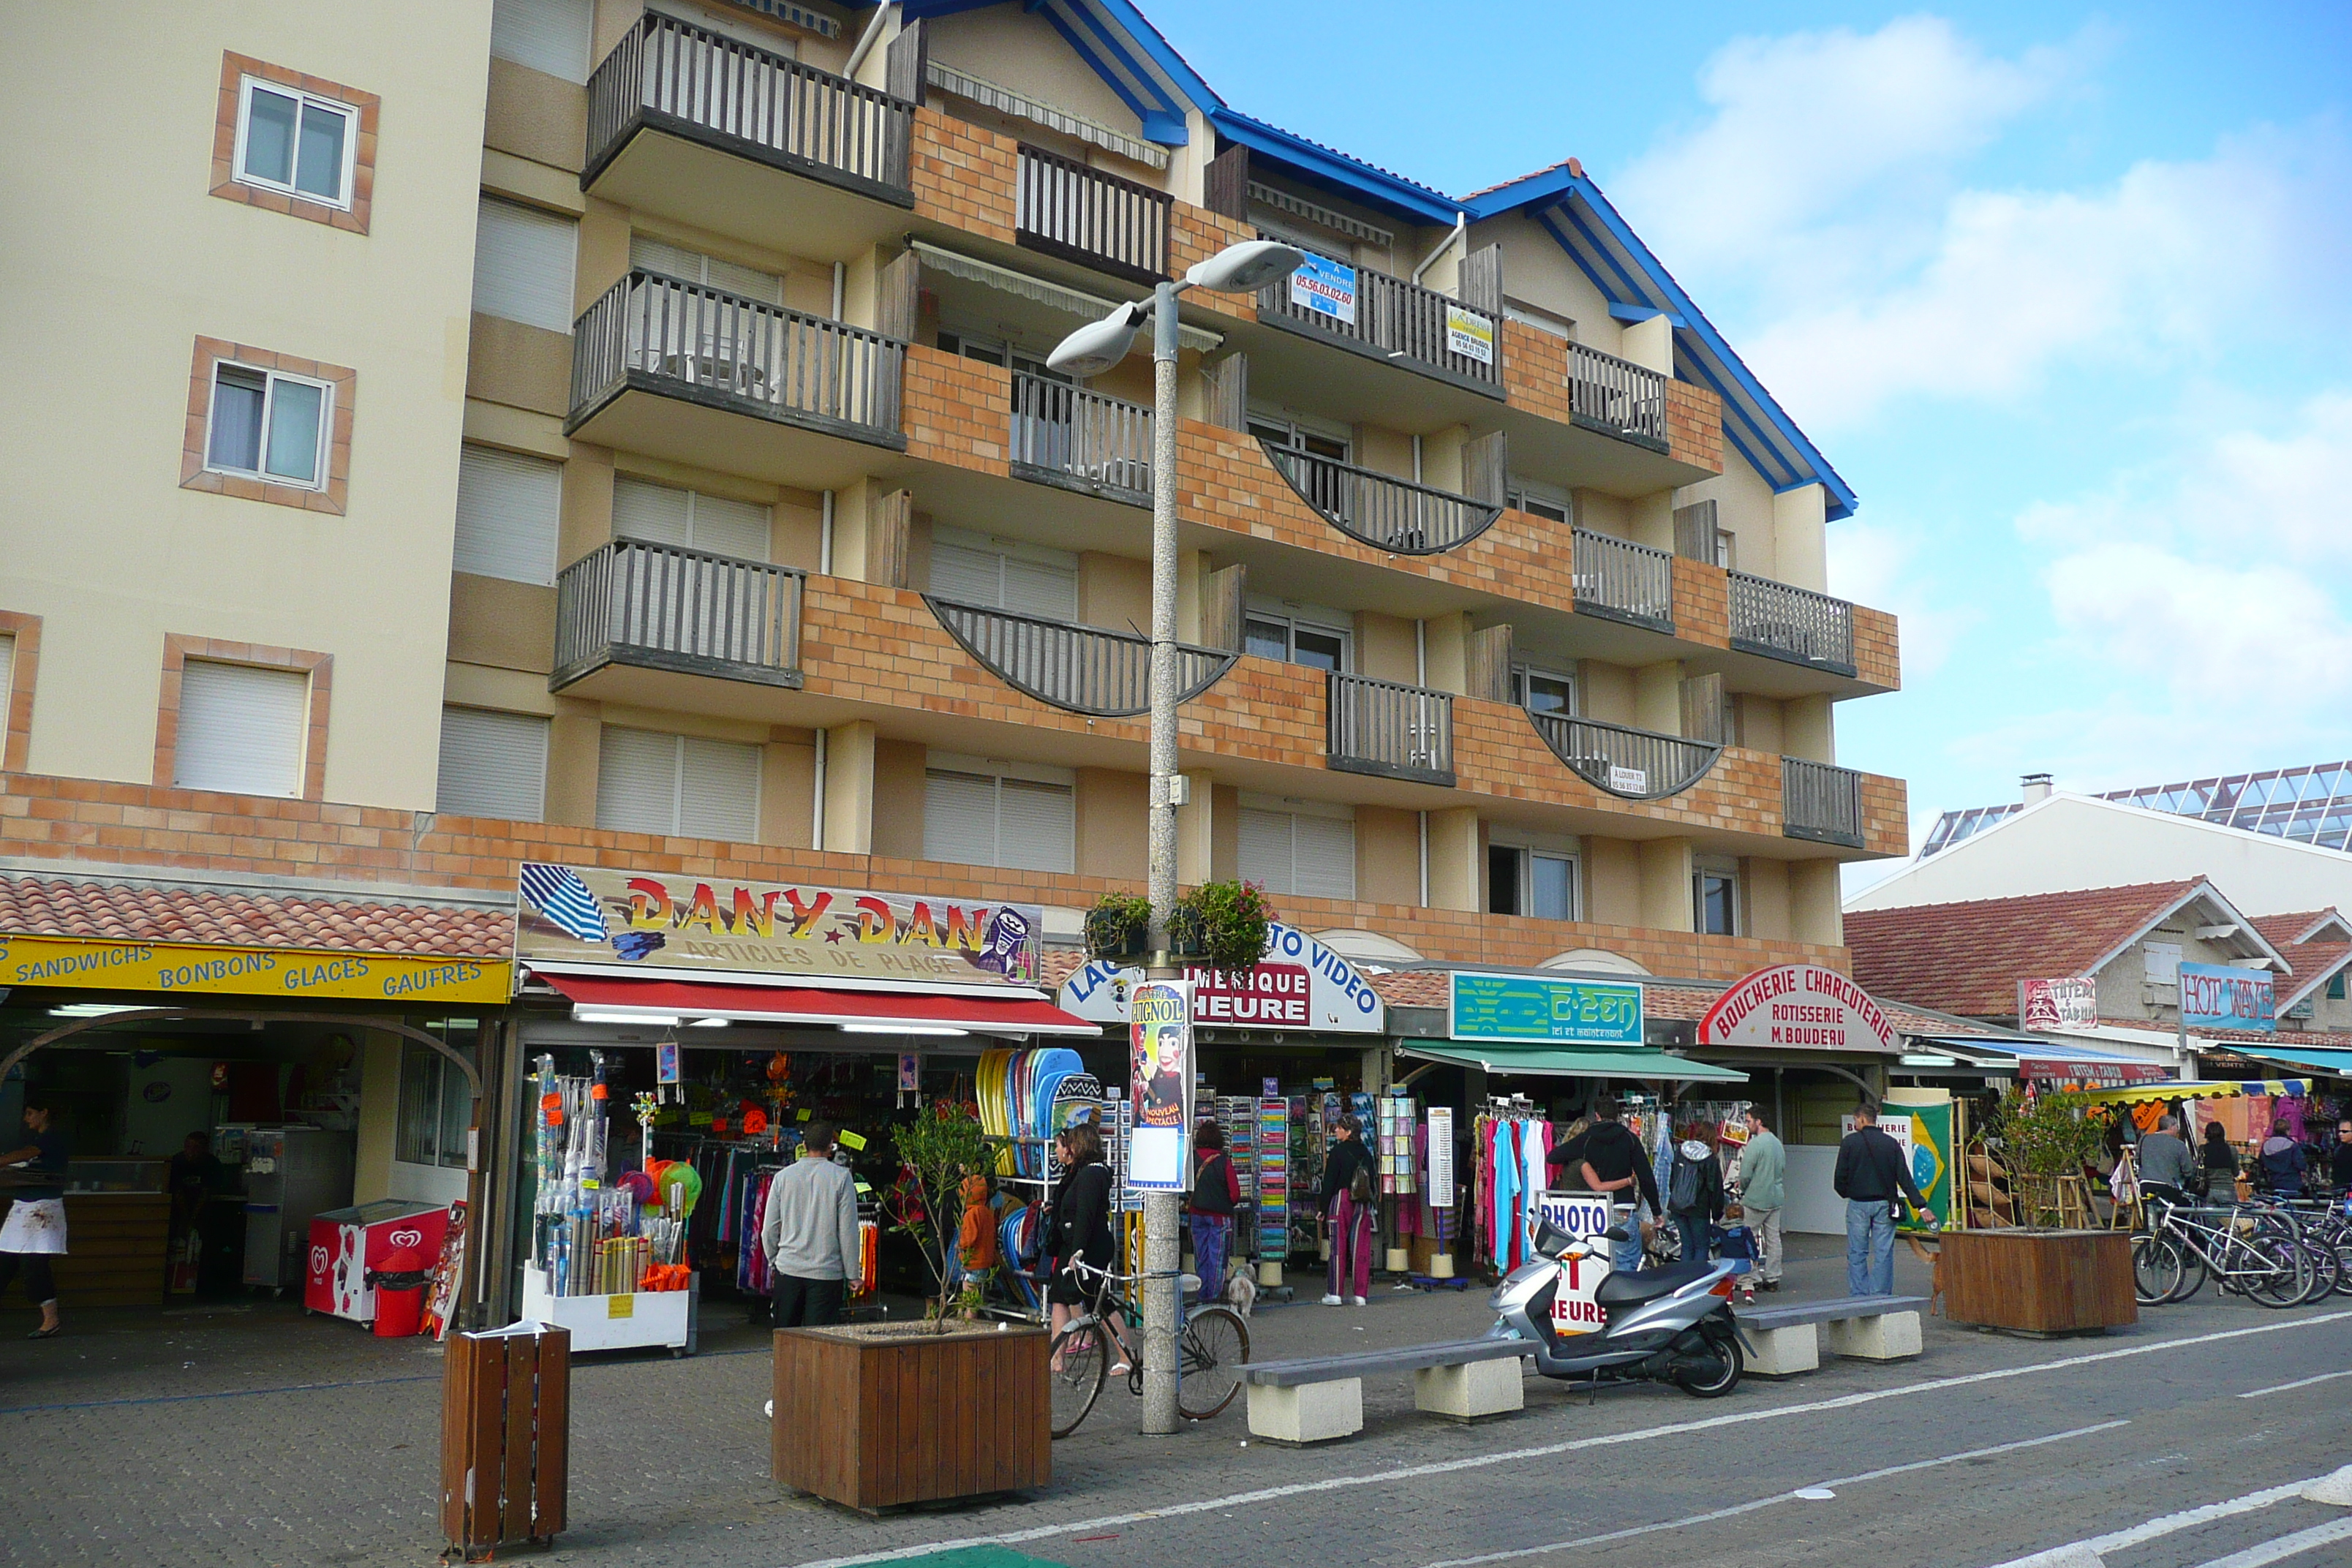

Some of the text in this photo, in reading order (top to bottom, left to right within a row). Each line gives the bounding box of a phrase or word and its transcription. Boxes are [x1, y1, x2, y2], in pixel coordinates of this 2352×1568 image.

[1296, 275, 1352, 304] 05.56.03.02.60
[1319, 270, 1354, 289] VENDRE
[1452, 331, 1469, 342] AGENCE
[1619, 770, 1635, 780] LOUER
[625, 878, 989, 951] DANY DAN
[15, 946, 482, 996] SANDWICHS BONBONS GLACES GAUFRES
[685, 941, 960, 973] ARTICLES DE PLAGE
[1313, 941, 1376, 1014] VIDEO
[1131, 1000, 1183, 1022] GUIGNOL
[1716, 970, 1893, 1047] BOUCHERIE CHARCUTERIE
[2182, 974, 2274, 1020] HOT WAVE
[1772, 1003, 1844, 1024] ROTISSERIE
[1577, 1028, 1624, 1039] maintenant
[1147, 1102, 1179, 1117] NOUVEAU
[1541, 1205, 1606, 1235] PHOTO
